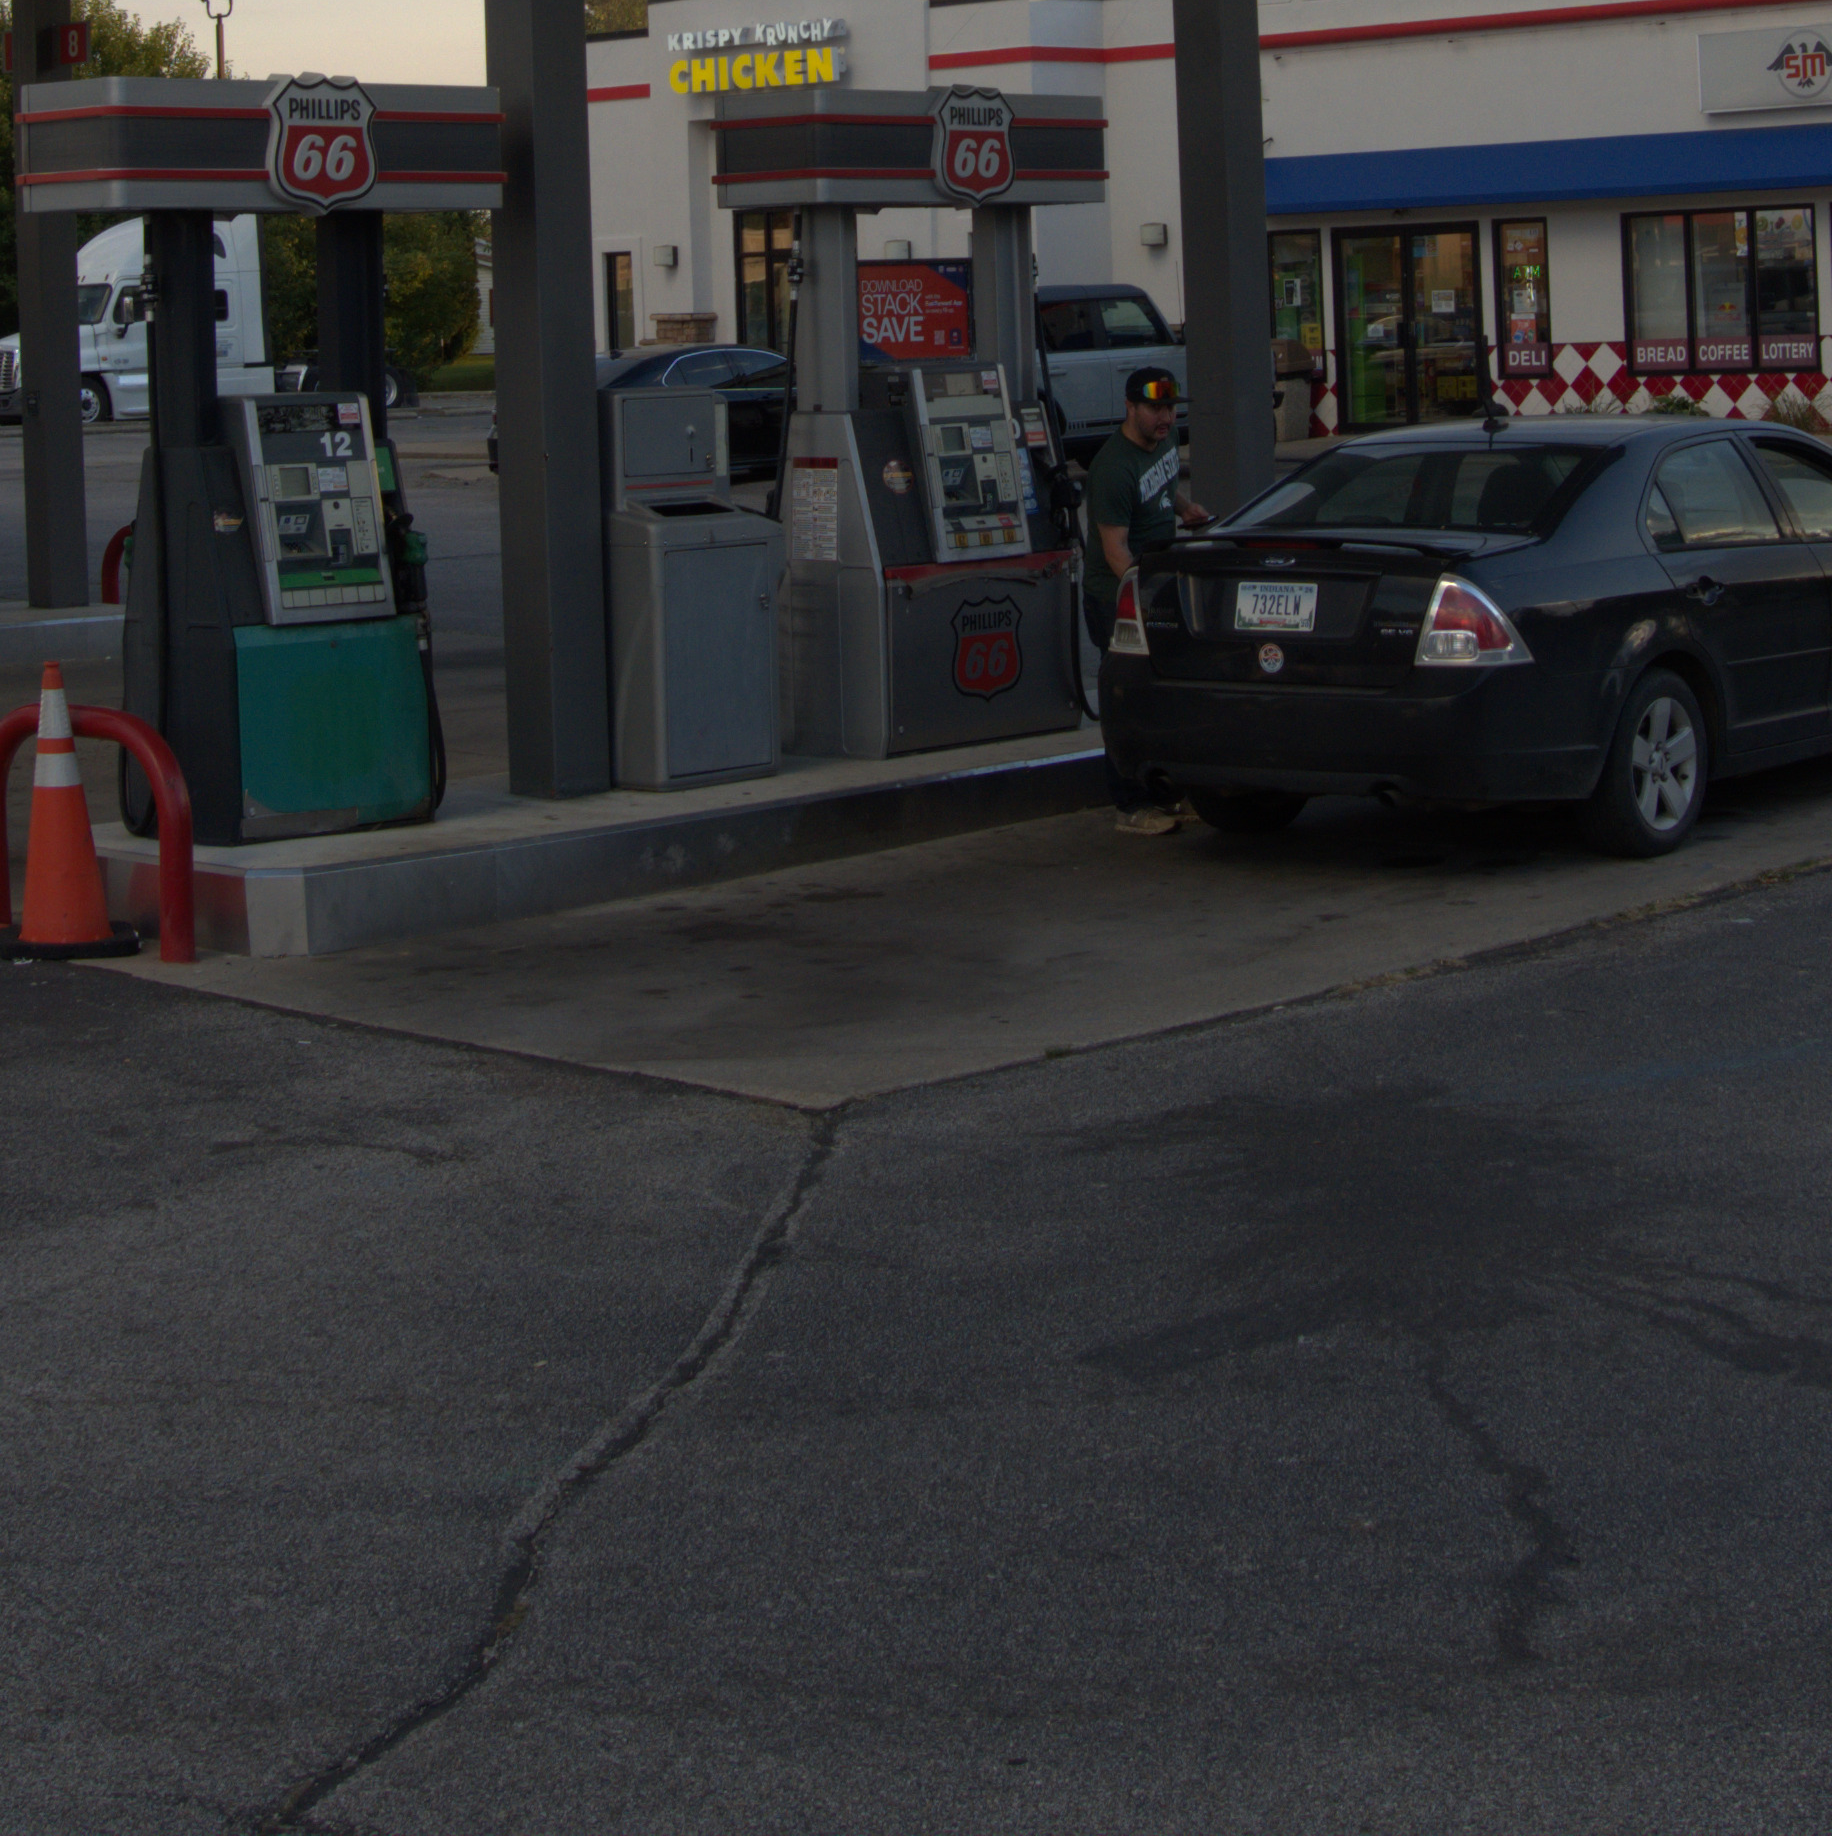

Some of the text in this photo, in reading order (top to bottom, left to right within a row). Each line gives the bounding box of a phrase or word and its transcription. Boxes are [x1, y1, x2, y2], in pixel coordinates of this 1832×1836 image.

[68, 30, 78, 57] 8
[668, 18, 832, 51] KRISPY KRUNCHY
[670, 47, 833, 93] CHICKEN
[289, 98, 360, 120] PHILLIPS
[950, 107, 1003, 126] PHILLIPS
[294, 134, 357, 181] 66
[954, 138, 1001, 178] 66
[1514, 265, 1540, 278] ATM
[862, 279, 923, 293] DOWNLOAD
[862, 293, 923, 316] STACK
[862, 316, 925, 344] SAVE
[1508, 350, 1546, 366] DELI
[1637, 346, 1686, 362] BREAD
[1699, 344, 1749, 361] COFFEE
[1762, 343, 1814, 359] LOTTERY
[320, 432, 352, 457] 12
[962, 610, 1011, 632] PHILLIPS
[966, 639, 1009, 680] 66
